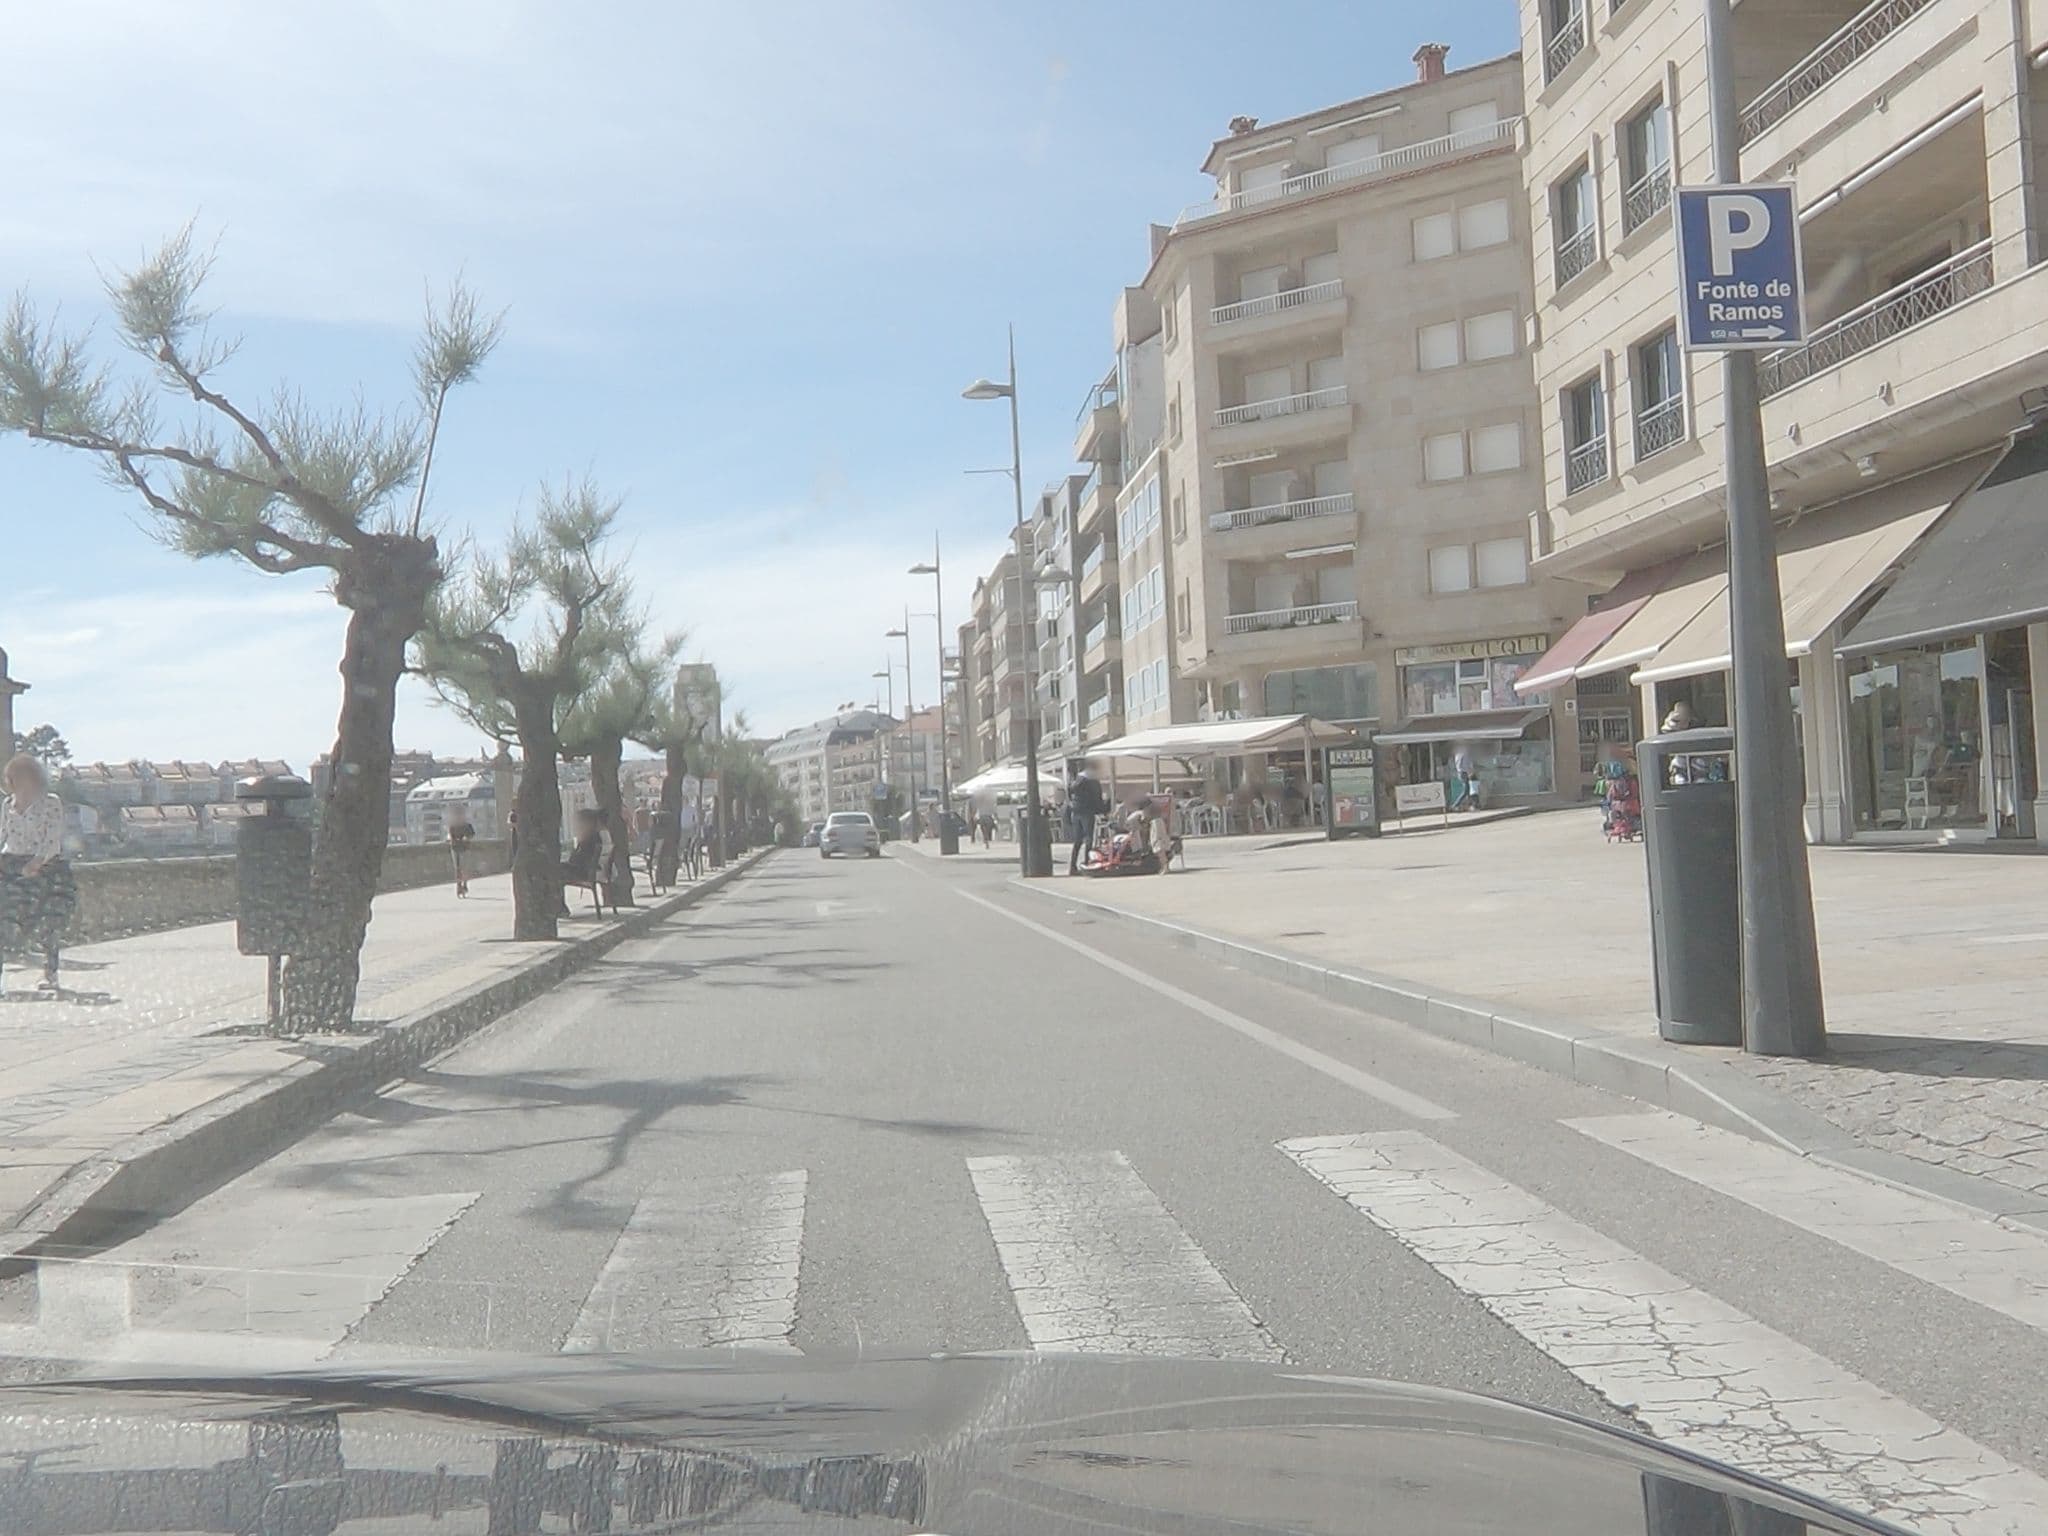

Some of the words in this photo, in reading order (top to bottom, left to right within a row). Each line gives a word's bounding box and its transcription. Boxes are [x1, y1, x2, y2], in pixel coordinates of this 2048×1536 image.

[1708, 194, 1771, 276] P
[1698, 281, 1759, 300] Fonte
[1765, 279, 1791, 297] de
[1709, 303, 1783, 322] Ramos
